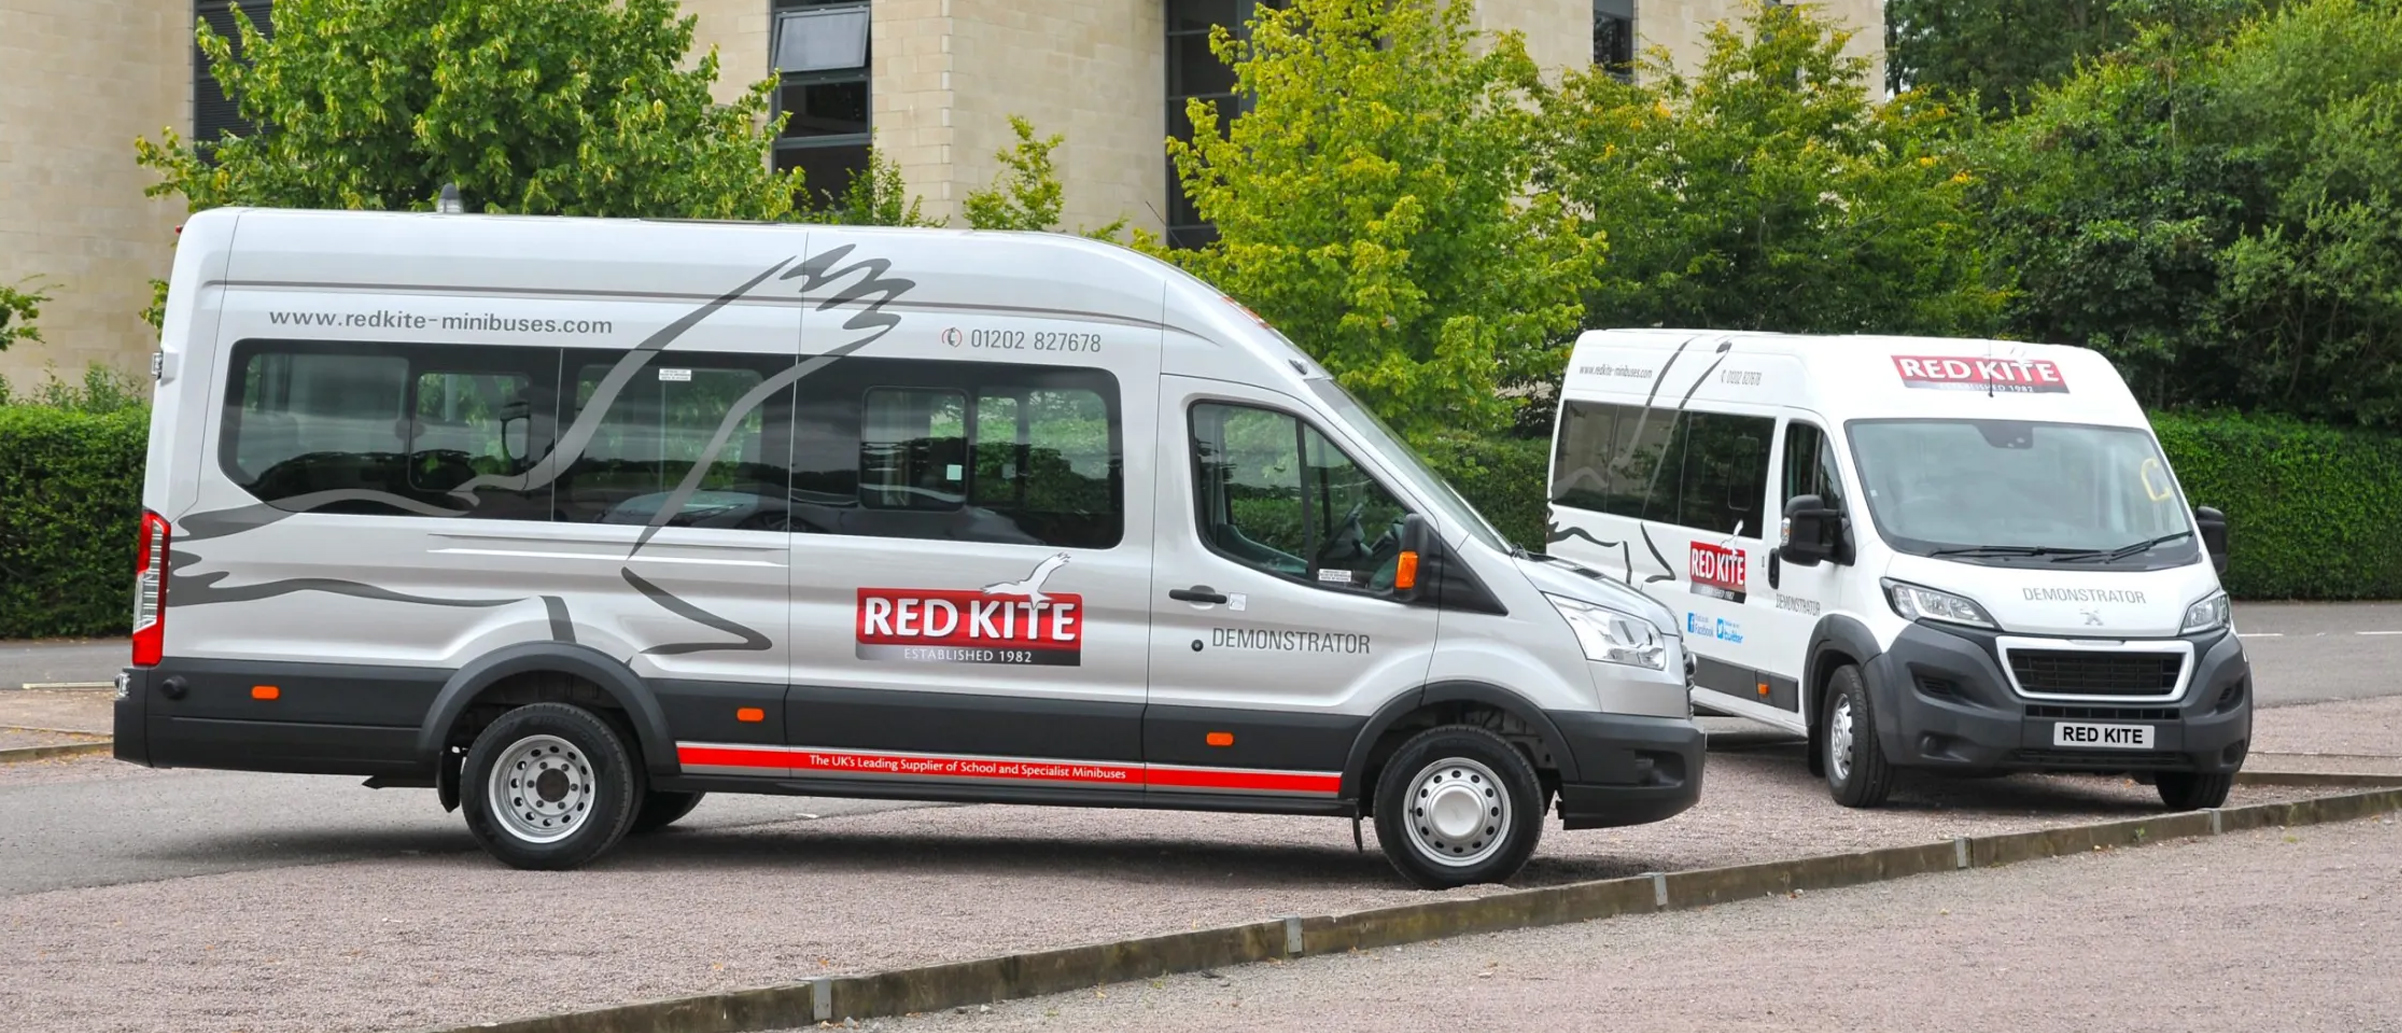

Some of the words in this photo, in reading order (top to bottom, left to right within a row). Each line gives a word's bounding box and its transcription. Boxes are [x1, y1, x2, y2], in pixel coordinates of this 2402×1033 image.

[269, 310, 613, 334] www.redkite-minibuses.com
[971, 329, 1025, 349] 01202
[1034, 332, 1101, 352] 827678
[1899, 358, 1972, 379] RED
[1976, 360, 2060, 382] KITE
[1691, 547, 1715, 580] RED
[1717, 552, 1744, 585] KITE
[2022, 587, 2147, 604] DEMONSTRATOR
[864, 597, 958, 637] RED
[969, 600, 1076, 641] KITE
[1212, 627, 1371, 654] DEMONSTRATOR
[904, 648, 994, 662] ESTABLISHED
[999, 650, 1032, 663] 1982
[2063, 726, 2099, 742] RED
[2104, 728, 2144, 744] KITE
[809, 754, 829, 766] The
[831, 755, 856, 767] UK's
[858, 757, 899, 772] Leading
[900, 759, 944, 773] Supplier
[945, 760, 959, 772] of
[960, 762, 997, 774] School
[998, 763, 1019, 775] and
[1021, 764, 1070, 778] Specialist
[1072, 767, 1127, 779] Minibuses
